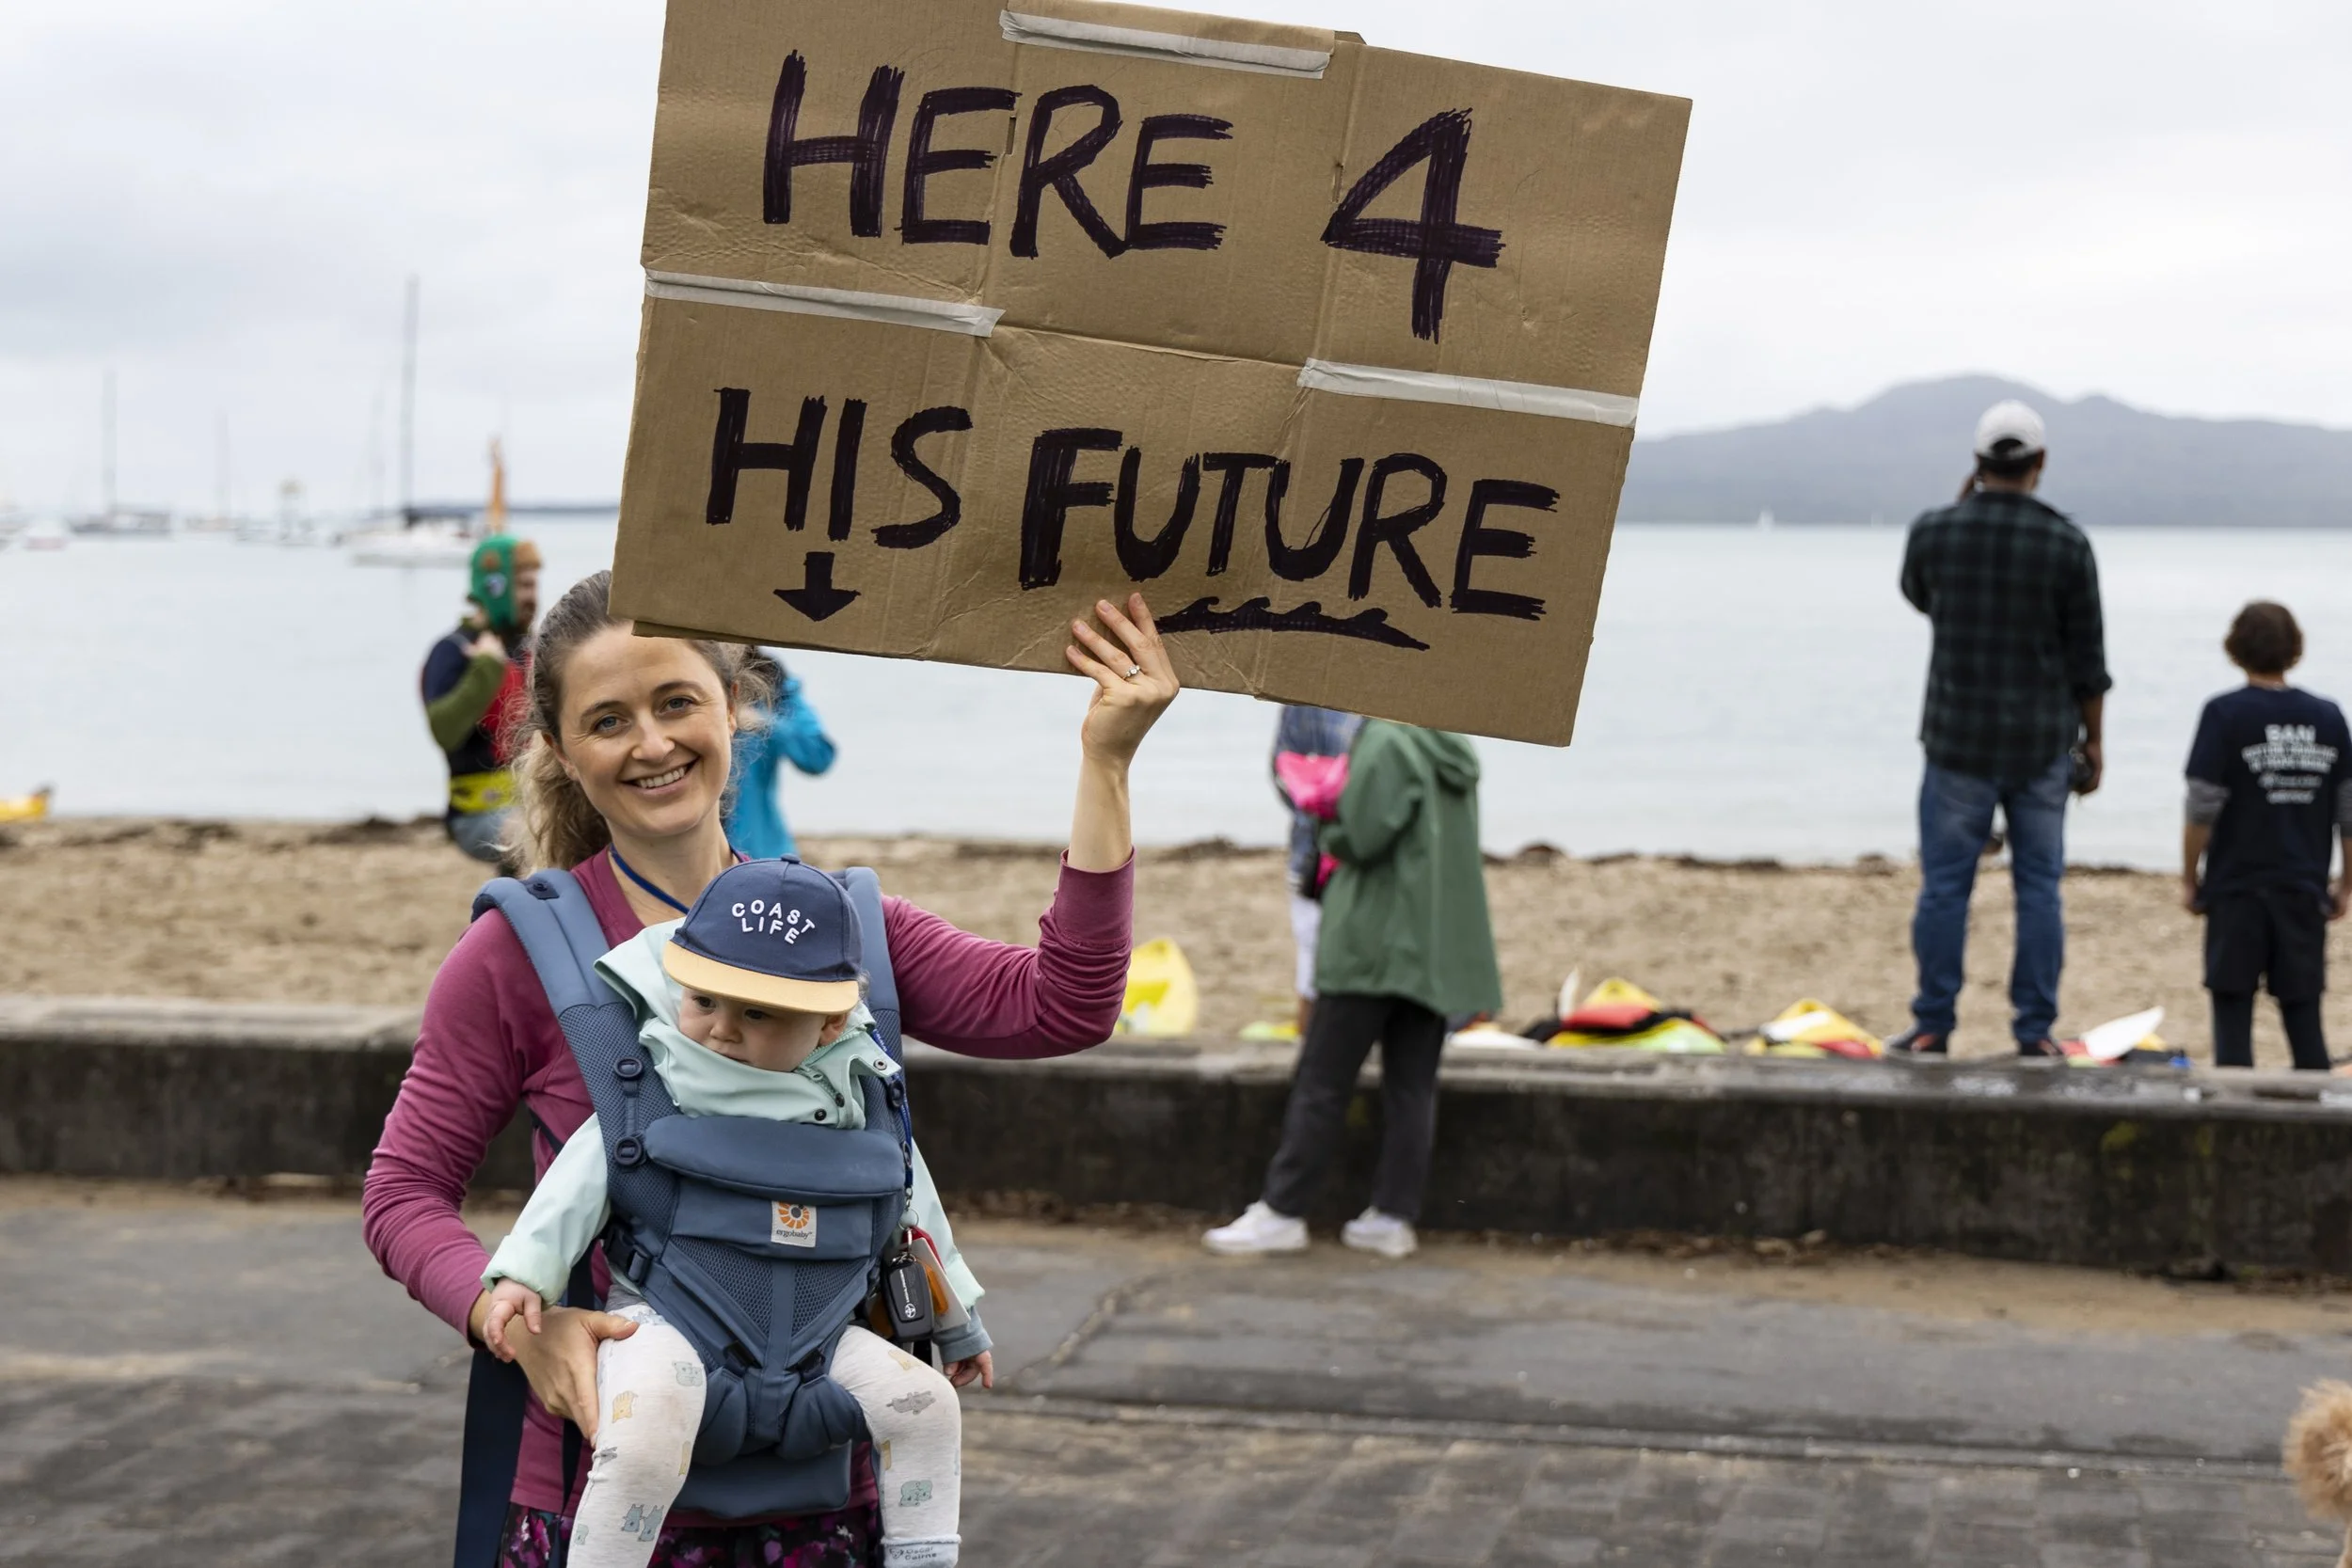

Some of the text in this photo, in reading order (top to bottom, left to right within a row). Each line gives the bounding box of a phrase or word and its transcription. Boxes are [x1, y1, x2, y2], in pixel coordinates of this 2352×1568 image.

[762, 50, 1508, 345] HERE 4
[706, 387, 1562, 621] HIS FUTURE
[731, 899, 816, 933] COAST
[741, 916, 800, 944] LIFE
